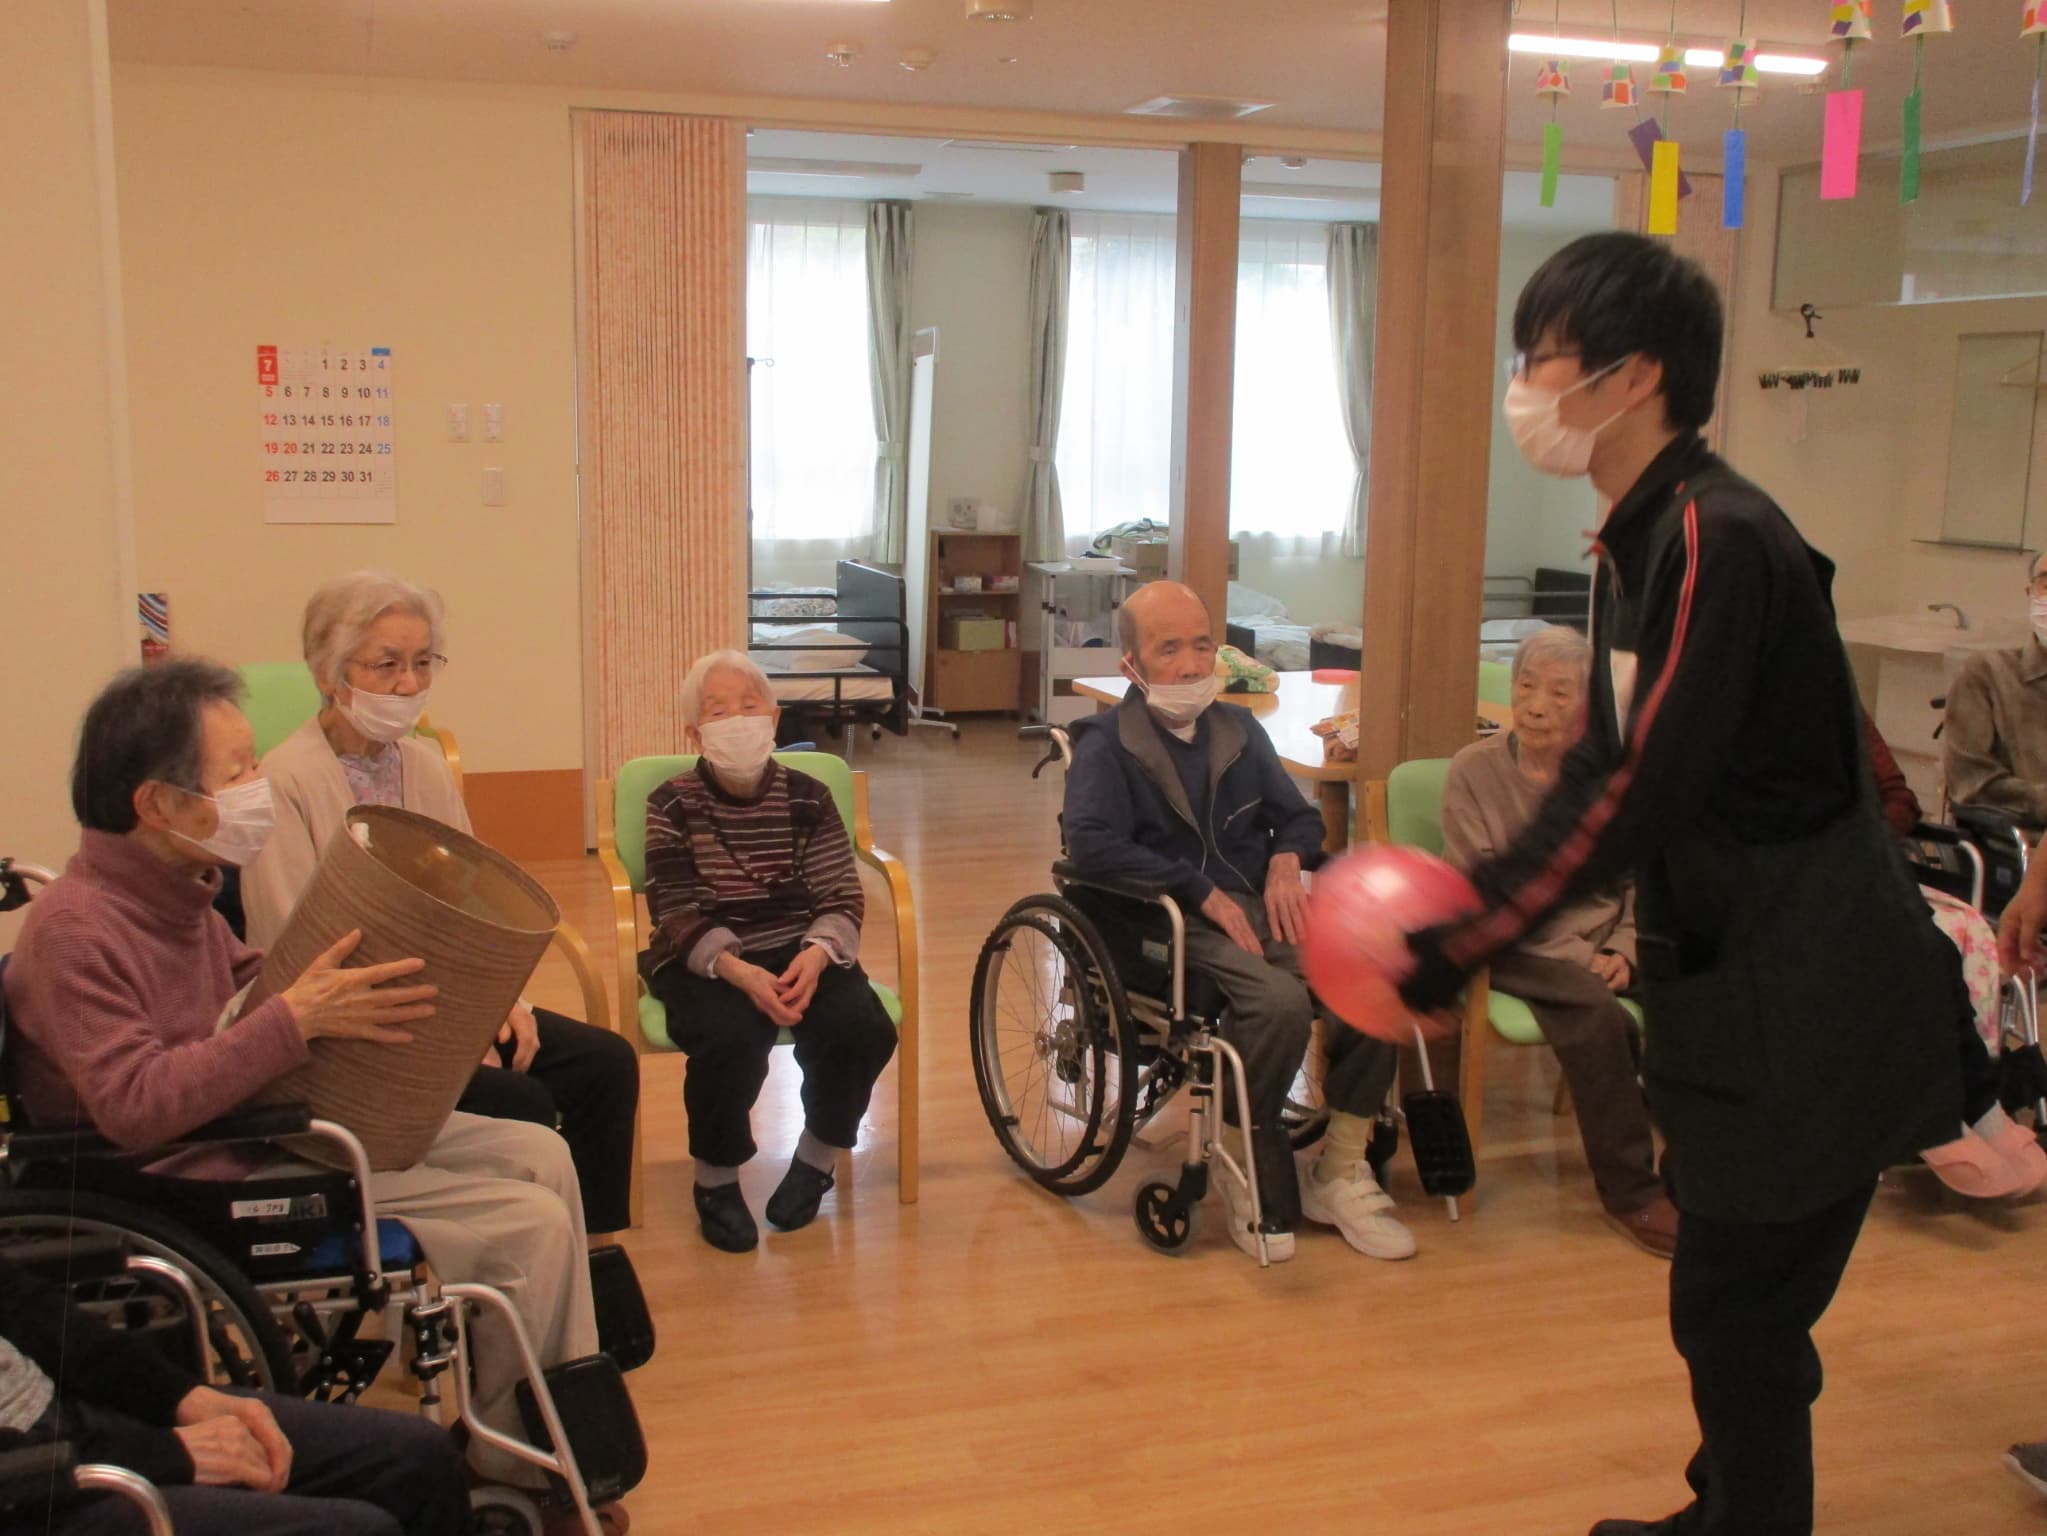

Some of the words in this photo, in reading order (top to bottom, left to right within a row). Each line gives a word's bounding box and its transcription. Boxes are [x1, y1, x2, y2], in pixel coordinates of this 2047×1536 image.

[264, 360, 272, 371] 7
[322, 360, 328, 370] 1
[340, 359, 348, 370] 2
[359, 360, 366, 370] 3
[378, 360, 385, 370] 4
[265, 386, 272, 397] 5
[285, 386, 292, 397] 6
[304, 387, 310, 397] 7
[322, 387, 330, 398] 8
[341, 387, 349, 398] 9
[358, 388, 370, 398] 10
[376, 388, 388, 398] 11
[264, 414, 277, 425] 12
[283, 416, 296, 426] 13
[302, 416, 315, 426] 14
[321, 416, 334, 426] 15
[340, 416, 353, 426] 16
[358, 416, 371, 426] 17
[377, 416, 390, 426] 18
[265, 443, 278, 454] 19
[284, 443, 297, 454] 20
[302, 444, 315, 454] 21
[321, 444, 335, 454] 22
[340, 444, 354, 454] 23
[359, 444, 372, 454] 24
[377, 444, 391, 454] 25
[265, 471, 279, 481] 26
[284, 471, 297, 482] 27
[303, 471, 317, 482] 28
[322, 471, 336, 482] 29
[341, 472, 354, 482] 30
[359, 471, 372, 482] 31
